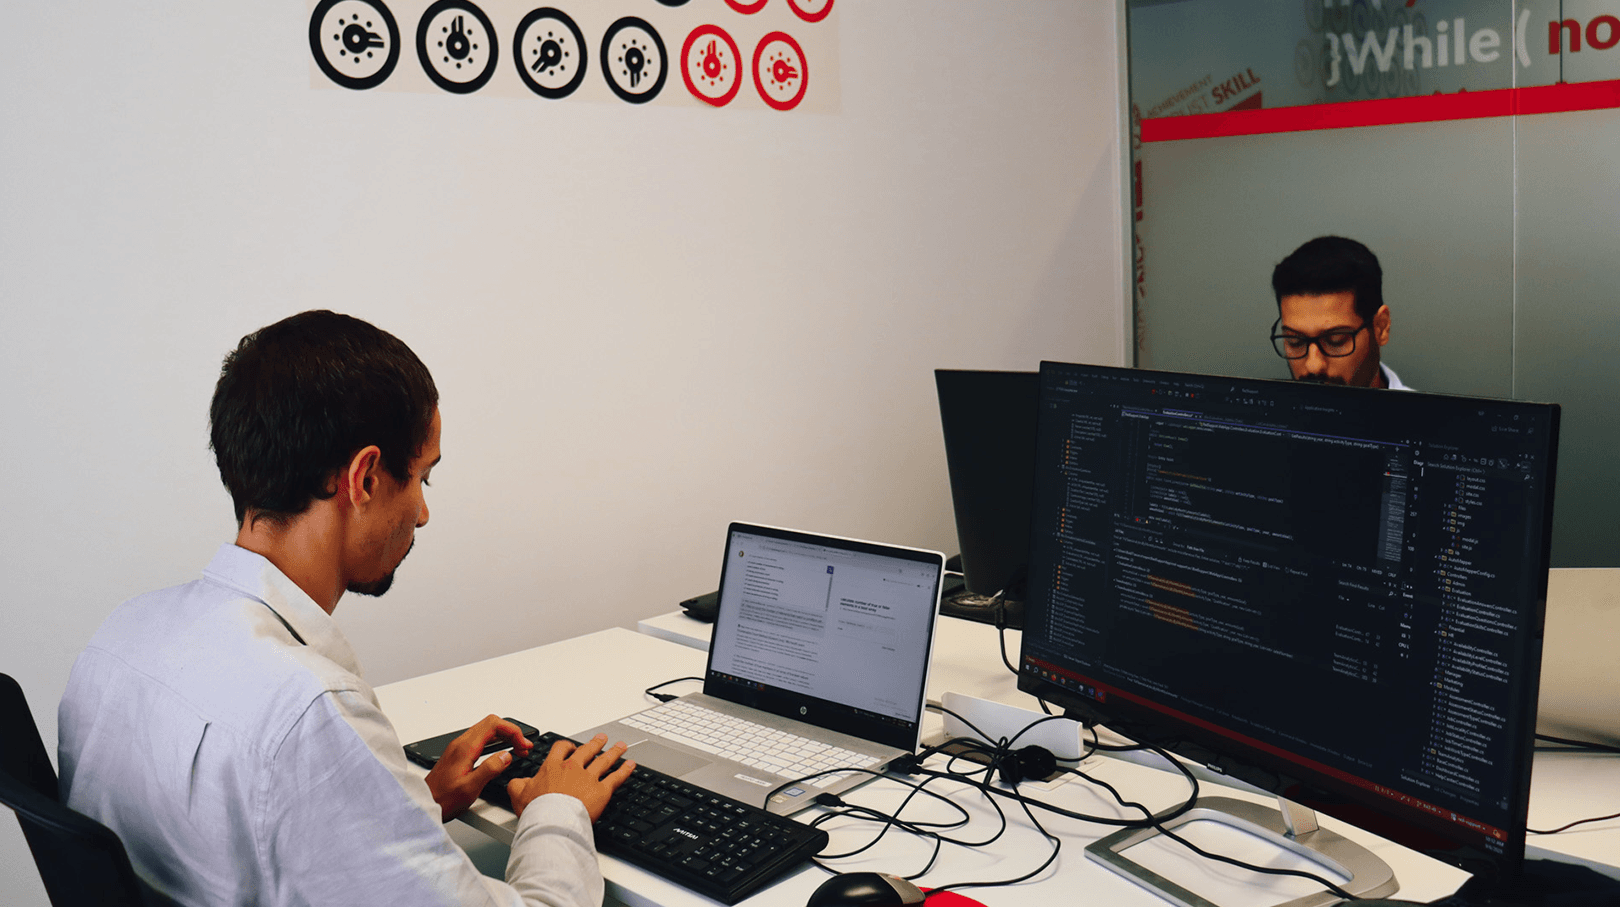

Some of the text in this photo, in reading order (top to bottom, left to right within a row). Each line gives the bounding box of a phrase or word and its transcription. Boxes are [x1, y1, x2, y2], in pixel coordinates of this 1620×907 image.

[1548, 14, 1620, 55] no
[1211, 67, 1261, 105] SKILL
[1448, 556, 1472, 565] AutoMapper
[1447, 571, 1467, 580] Controllers
[1454, 565, 1495, 578] AutoMapperConfig.cs
[1451, 588, 1471, 596] Evaluation
[1456, 604, 1500, 618] EvaluationController.cs
[1448, 624, 1465, 633] Financial
[1453, 642, 1498, 657] AvailabilityController.cs
[1444, 669, 1462, 678] Manager
[1443, 684, 1460, 693] Modules
[1444, 677, 1464, 687] Marketing
[1437, 758, 1468, 773] BaseController.cs
[1401, 774, 1430, 788] Solution Explorer
[1435, 765, 1480, 784] DashboardController.cs
[1435, 773, 1480, 792] HelpCenterController.cs
